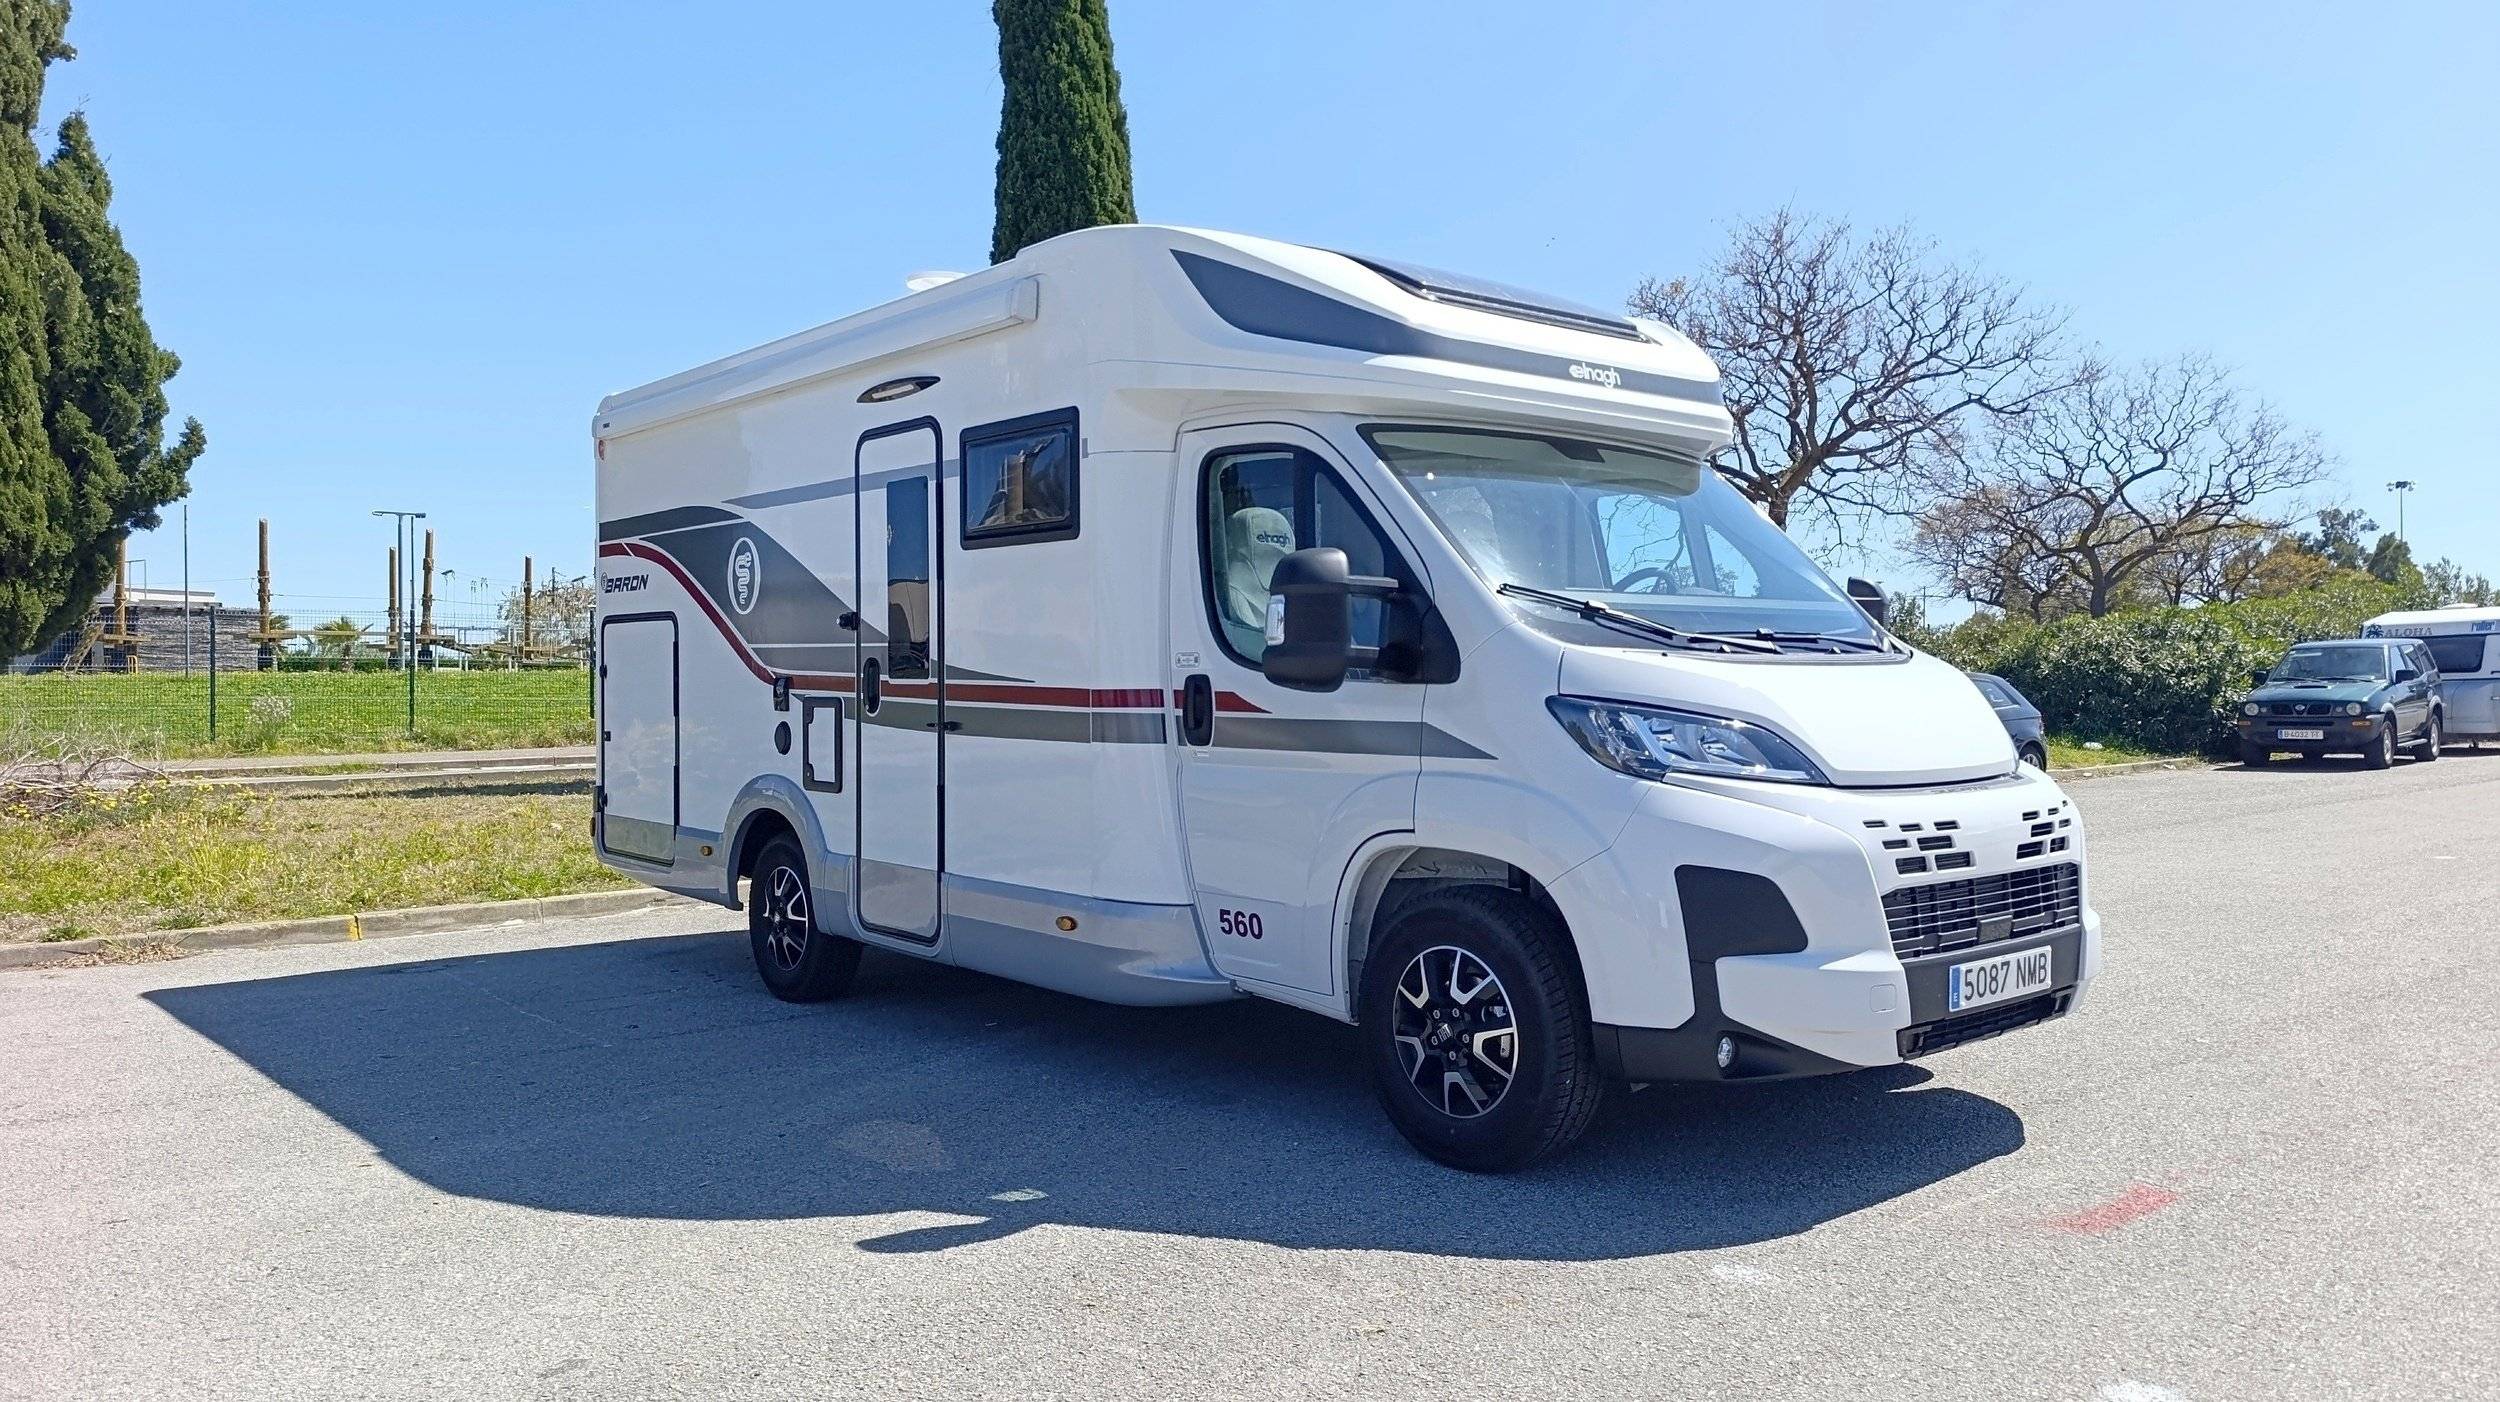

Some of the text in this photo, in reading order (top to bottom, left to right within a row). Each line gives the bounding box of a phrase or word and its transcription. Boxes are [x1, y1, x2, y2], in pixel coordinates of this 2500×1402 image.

[1569, 361, 1621, 388] elnagh
[1256, 531, 1290, 547] elnagh
[605, 574, 649, 593] BARON
[2384, 627, 2433, 638] ALOHA
[1219, 908, 1263, 939] 560
[1964, 952, 2047, 1001] 5087 NMB
